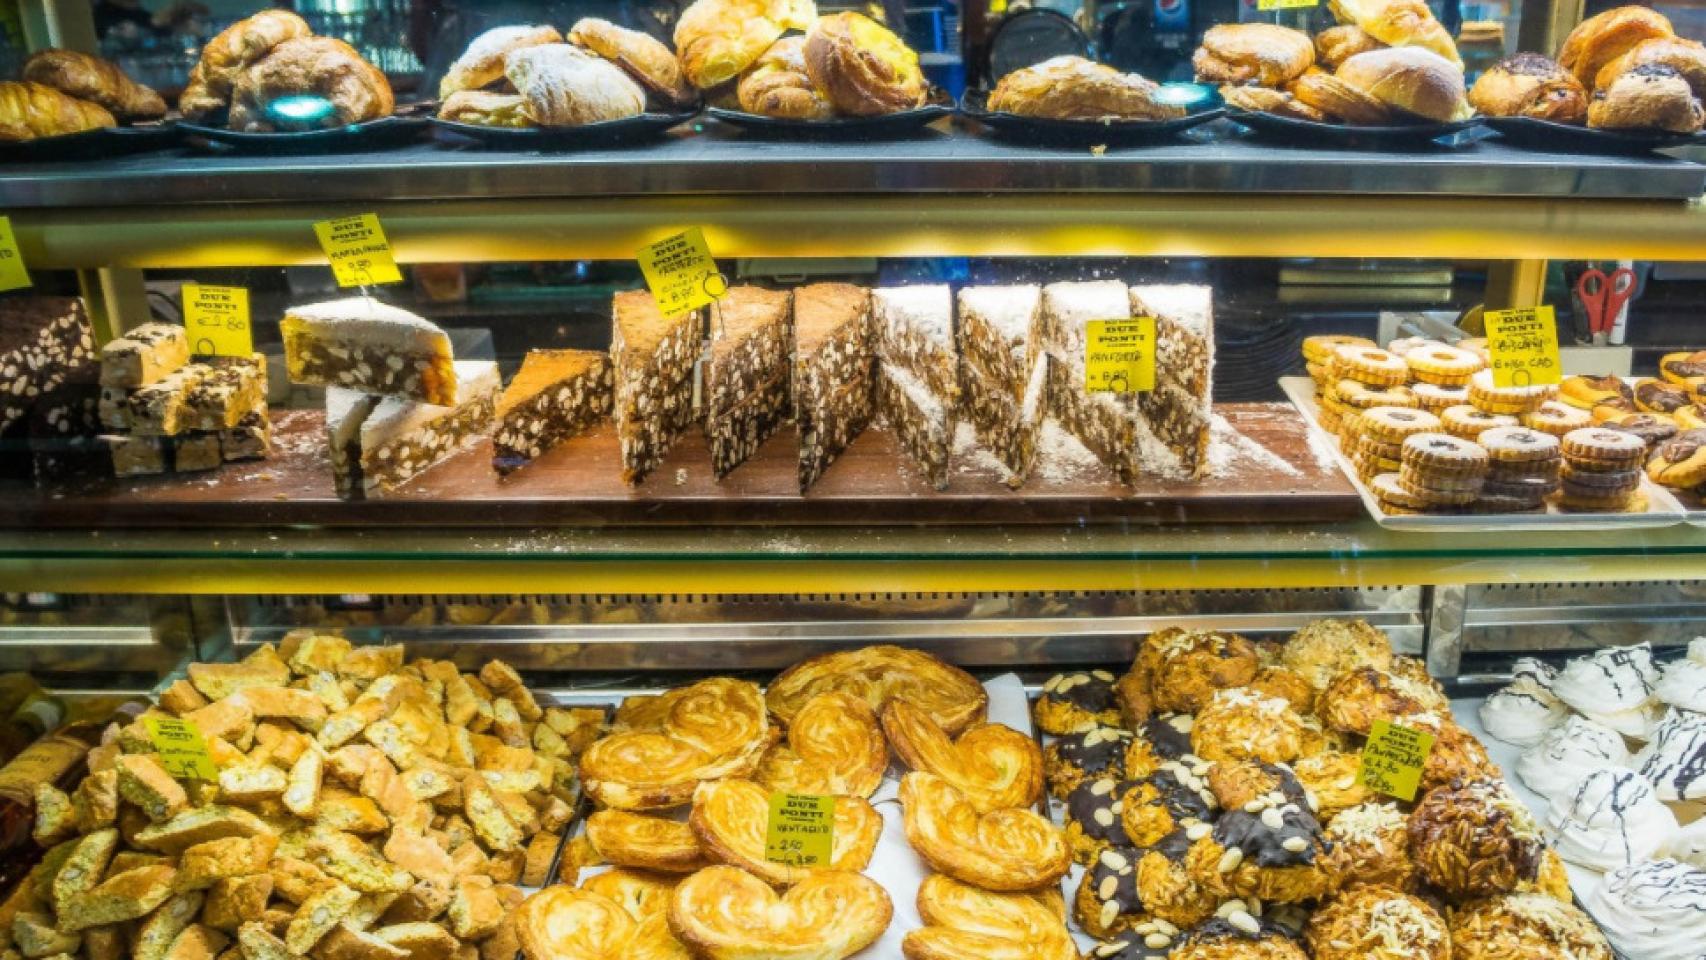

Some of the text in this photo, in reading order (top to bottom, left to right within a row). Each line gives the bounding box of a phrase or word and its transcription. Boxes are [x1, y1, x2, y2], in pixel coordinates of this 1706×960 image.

[1504, 314, 1537, 323] DUE
[1105, 325, 1138, 334] DUE
[1497, 323, 1544, 334] PONTI
[1098, 334, 1145, 343] PONTI
[787, 800, 818, 809] DUE
[780, 807, 824, 818] PONTI
